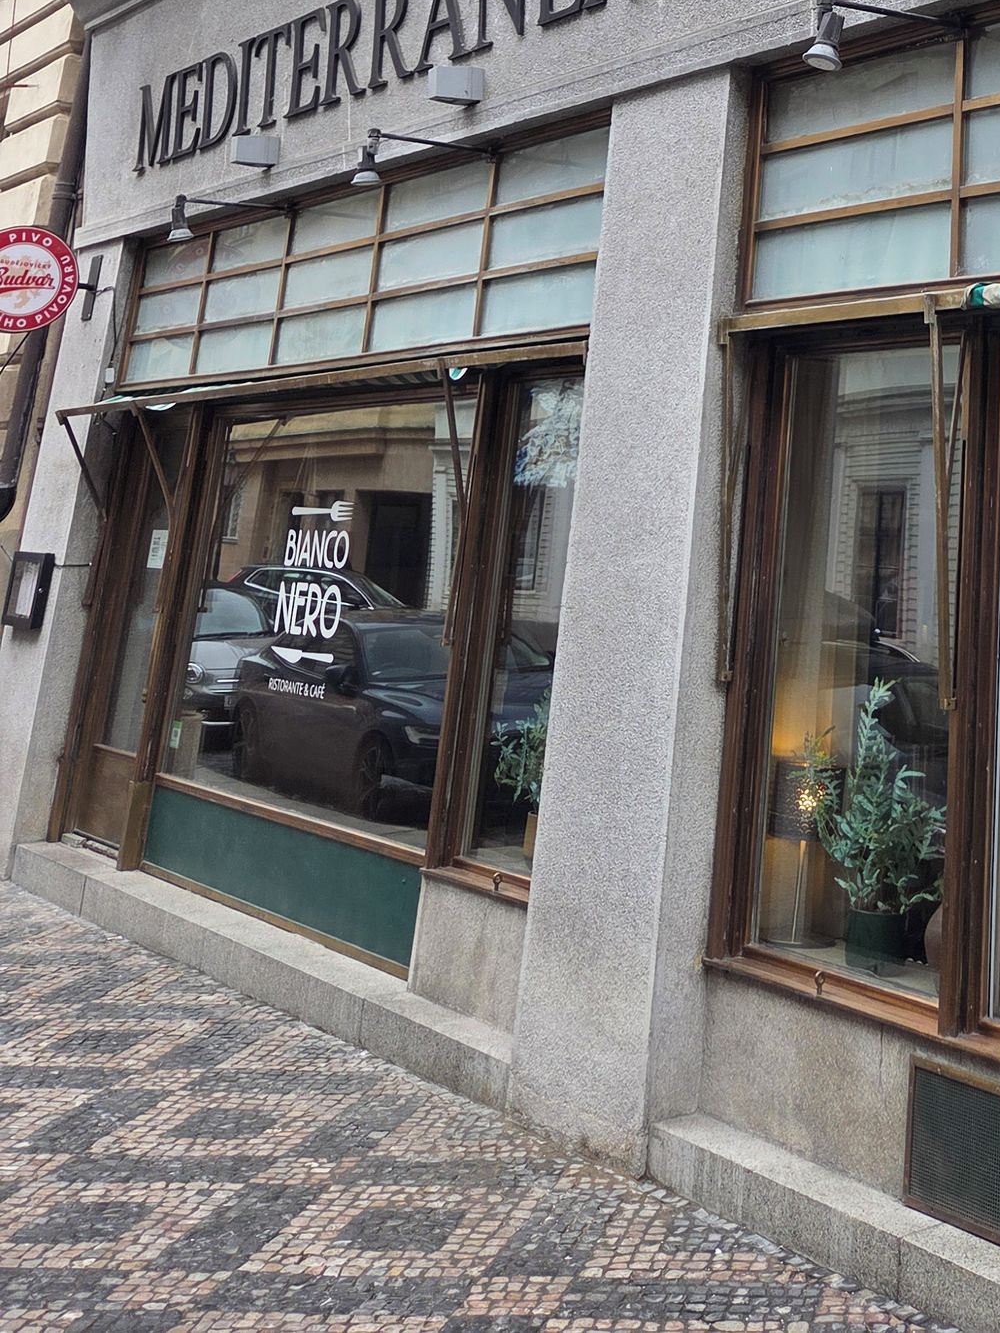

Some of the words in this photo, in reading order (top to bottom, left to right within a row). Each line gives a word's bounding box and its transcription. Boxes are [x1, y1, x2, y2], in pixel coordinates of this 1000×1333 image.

[8, 232, 53, 247] PIVO
[35, 254, 75, 324] PIVOVARU
[283, 528, 350, 570] BIANCO
[273, 579, 342, 640] NERO
[268, 677, 304, 696] RISTORANTE
[303, 683, 309, 697] &
[309, 682, 326, 700] CAFÉ
